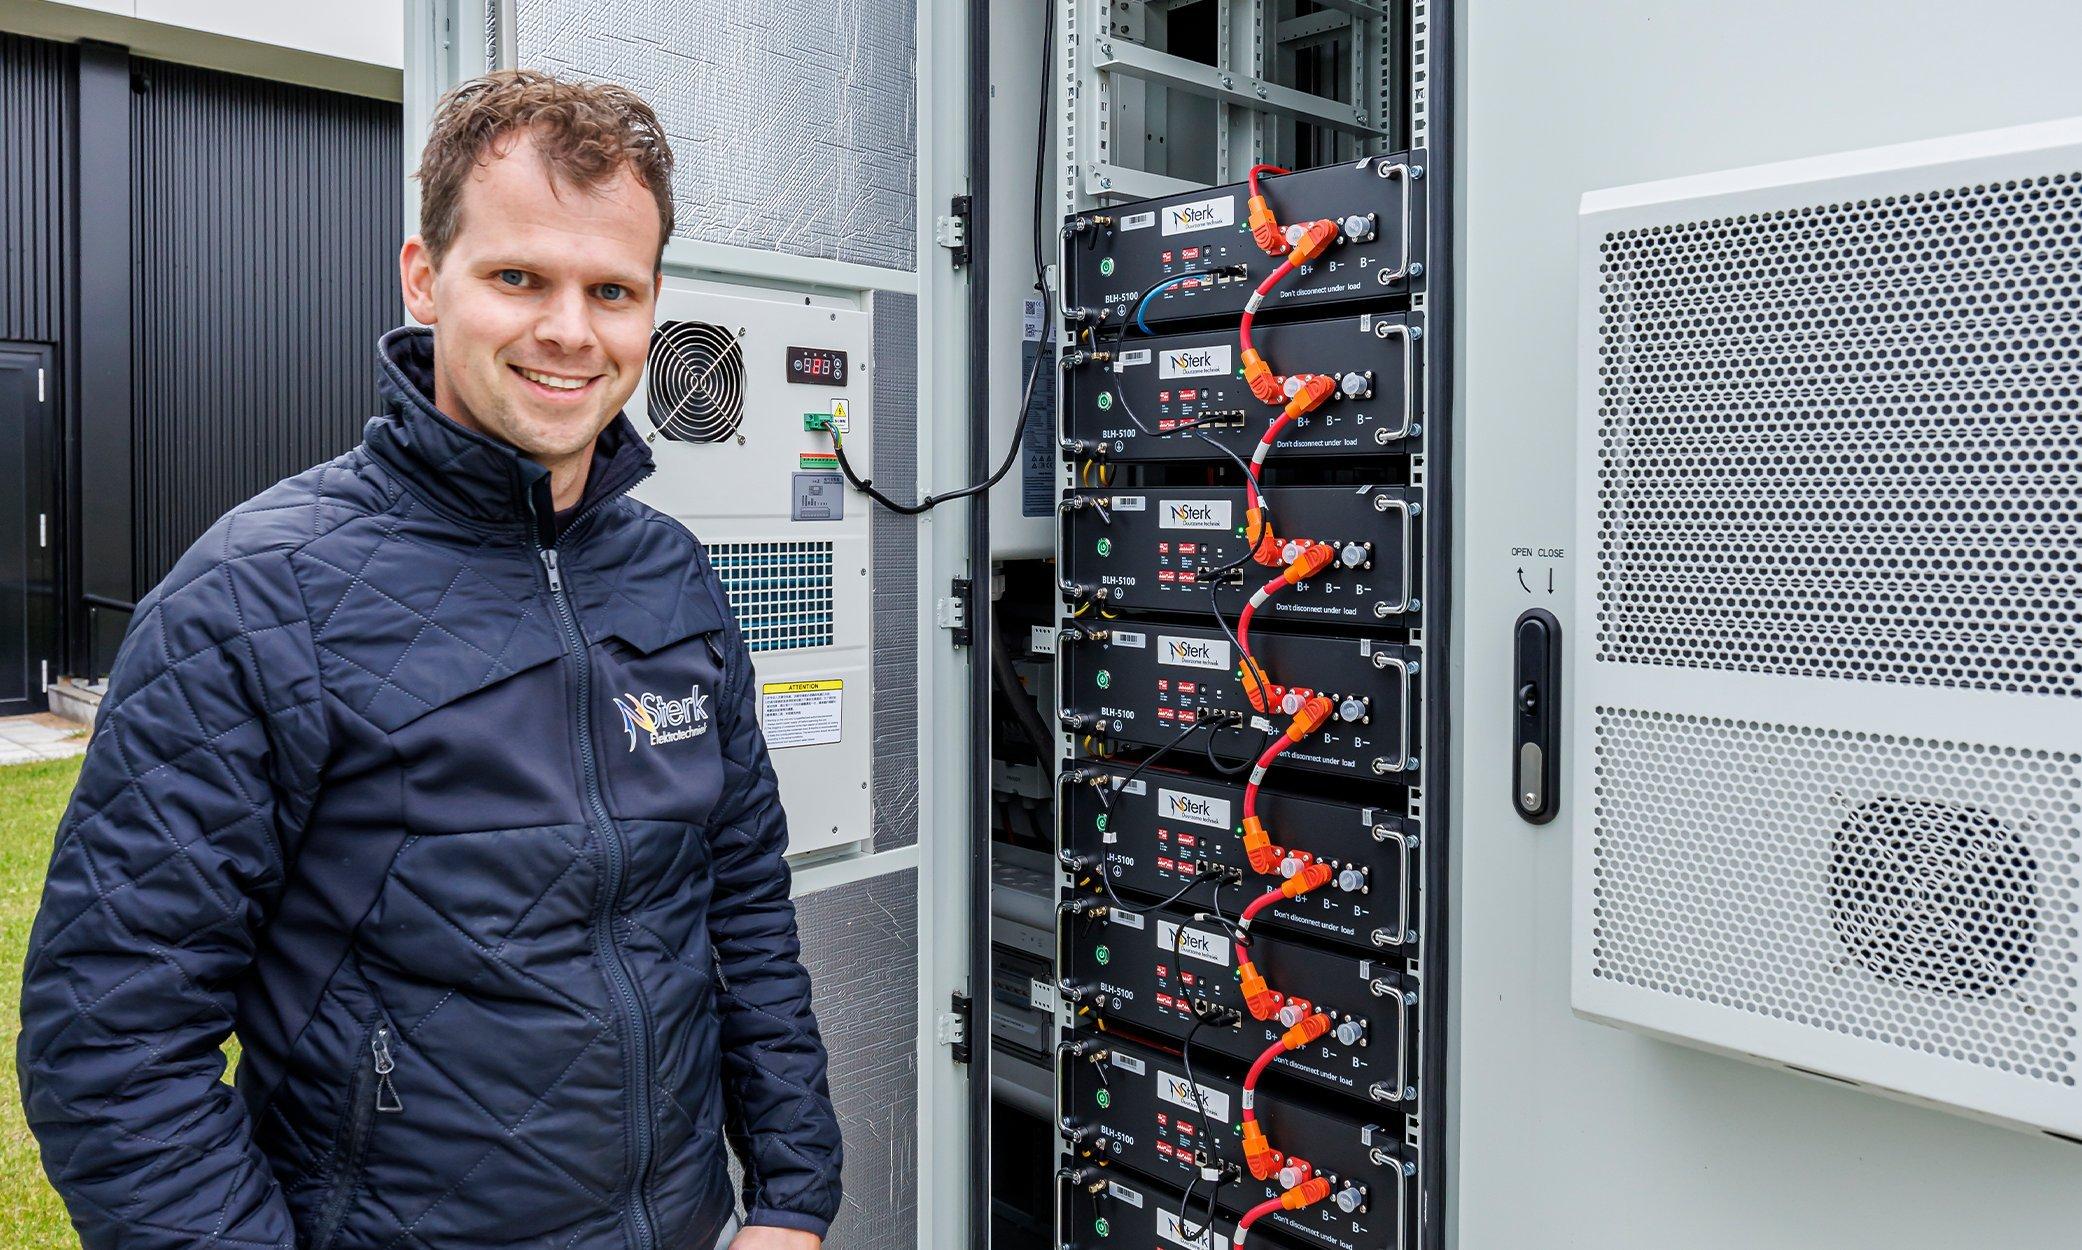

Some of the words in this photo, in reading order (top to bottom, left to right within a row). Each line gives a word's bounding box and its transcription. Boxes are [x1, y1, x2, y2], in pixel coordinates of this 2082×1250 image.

[1300, 265, 1314, 276] B+
[1296, 286, 1327, 296] disconnect
[1327, 284, 1345, 293] under
[1347, 282, 1361, 290] load
[1105, 291, 1139, 304] BLH-5100
[1297, 416, 1310, 427] B+
[1102, 428, 1136, 439] BLH-5100
[1325, 439, 1342, 447] under
[1344, 438, 1358, 446] load
[1511, 547, 1533, 557] OPEN
[1537, 548, 1564, 558] CLOSE
[1102, 575, 1136, 586] BLH-5100
[1297, 581, 1310, 592] B+
[1293, 604, 1323, 613] disconnect
[1323, 606, 1341, 614] under
[1343, 607, 1357, 615] load
[1101, 706, 1135, 720] BLH-5100
[650, 722, 708, 746] Elektrotechniek
[1278, 750, 1290, 759] on't
[1291, 751, 1321, 763] disconnect
[1322, 756, 1340, 765] under
[1341, 759, 1355, 768] load
[1290, 914, 1320, 927] disconnect
[1321, 922, 1339, 931] under
[1340, 925, 1355, 935] load
[1100, 982, 1134, 1000] BLH-5100
[1265, 1029, 1278, 1041] B+
[1289, 1060, 1319, 1076] disconnect
[1320, 1070, 1337, 1081] under
[1339, 1075, 1353, 1087] load
[1101, 1125, 1134, 1146] BLH-5100
[1265, 1187, 1278, 1198] B+
[1289, 1217, 1320, 1238] disconnect
[1320, 1232, 1337, 1245] under
[1339, 1238, 1353, 1250] load
